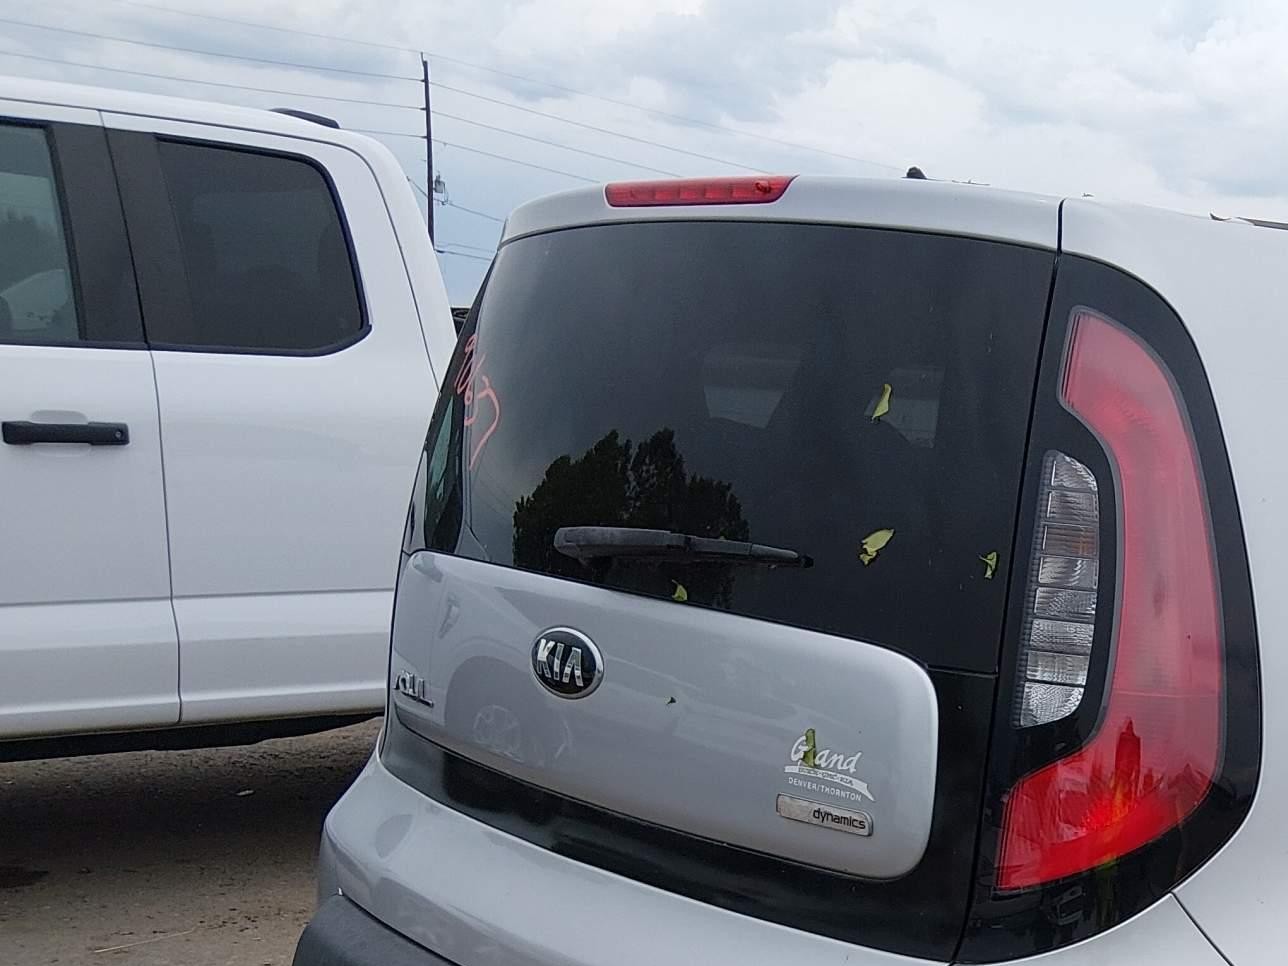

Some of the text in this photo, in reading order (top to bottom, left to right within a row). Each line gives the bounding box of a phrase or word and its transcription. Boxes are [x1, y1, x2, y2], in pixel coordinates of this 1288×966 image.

[536, 638, 584, 687] KIA
[790, 735, 862, 774] Gand
[788, 776, 862, 802] DENVER/THORNTON
[812, 807, 867, 830] dynamics
